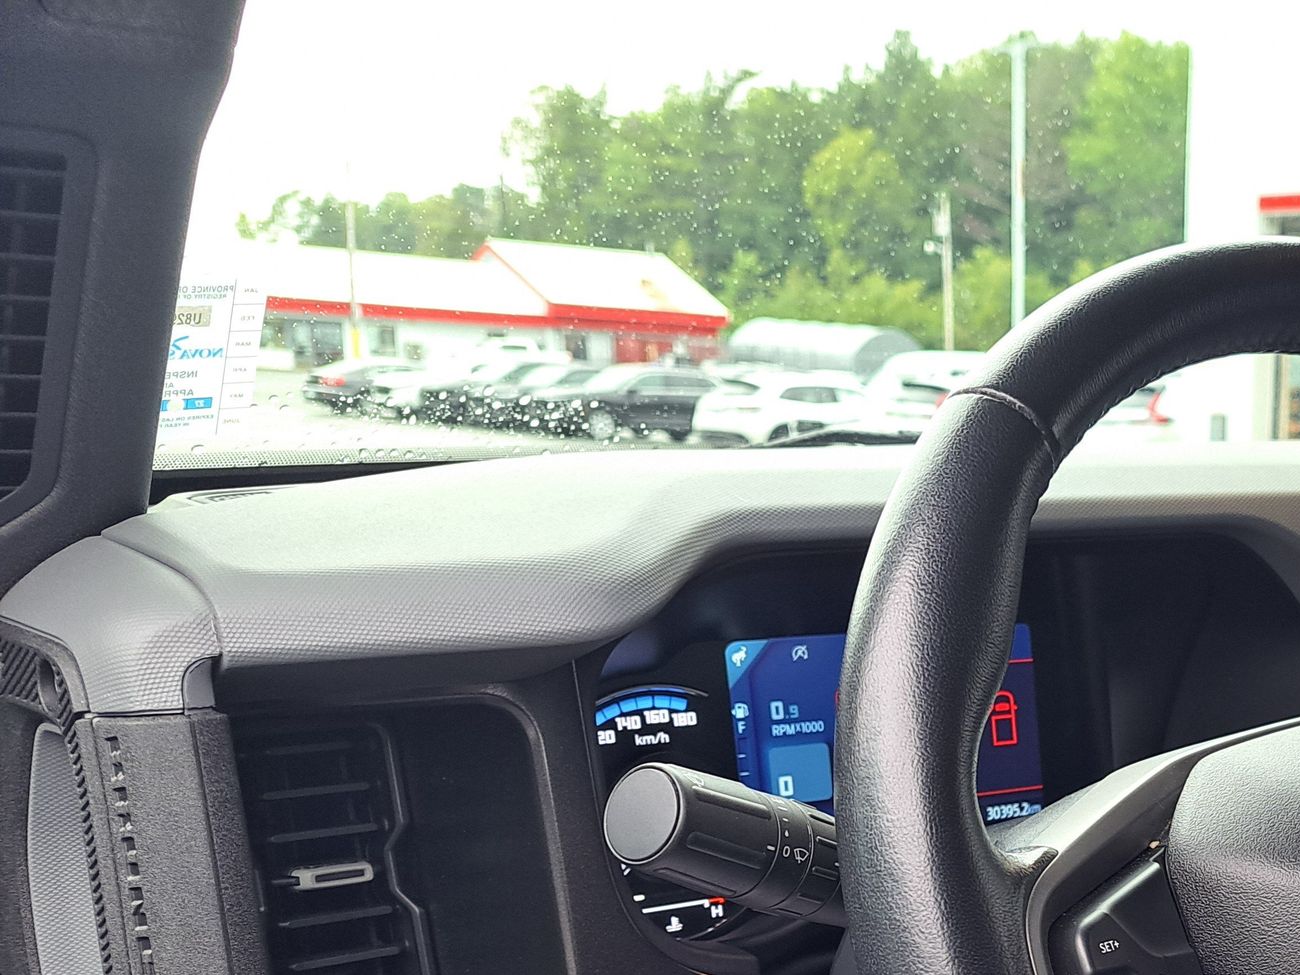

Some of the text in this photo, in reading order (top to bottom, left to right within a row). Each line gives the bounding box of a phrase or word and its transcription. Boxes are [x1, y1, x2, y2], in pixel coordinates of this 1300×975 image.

[614, 715, 642, 731] 140
[643, 709, 670, 724] 160
[671, 711, 697, 727] 180
[737, 721, 747, 735] F
[634, 731, 670, 746] km/h
[710, 904, 724, 918] H
[1099, 940, 1120, 954] SET+
